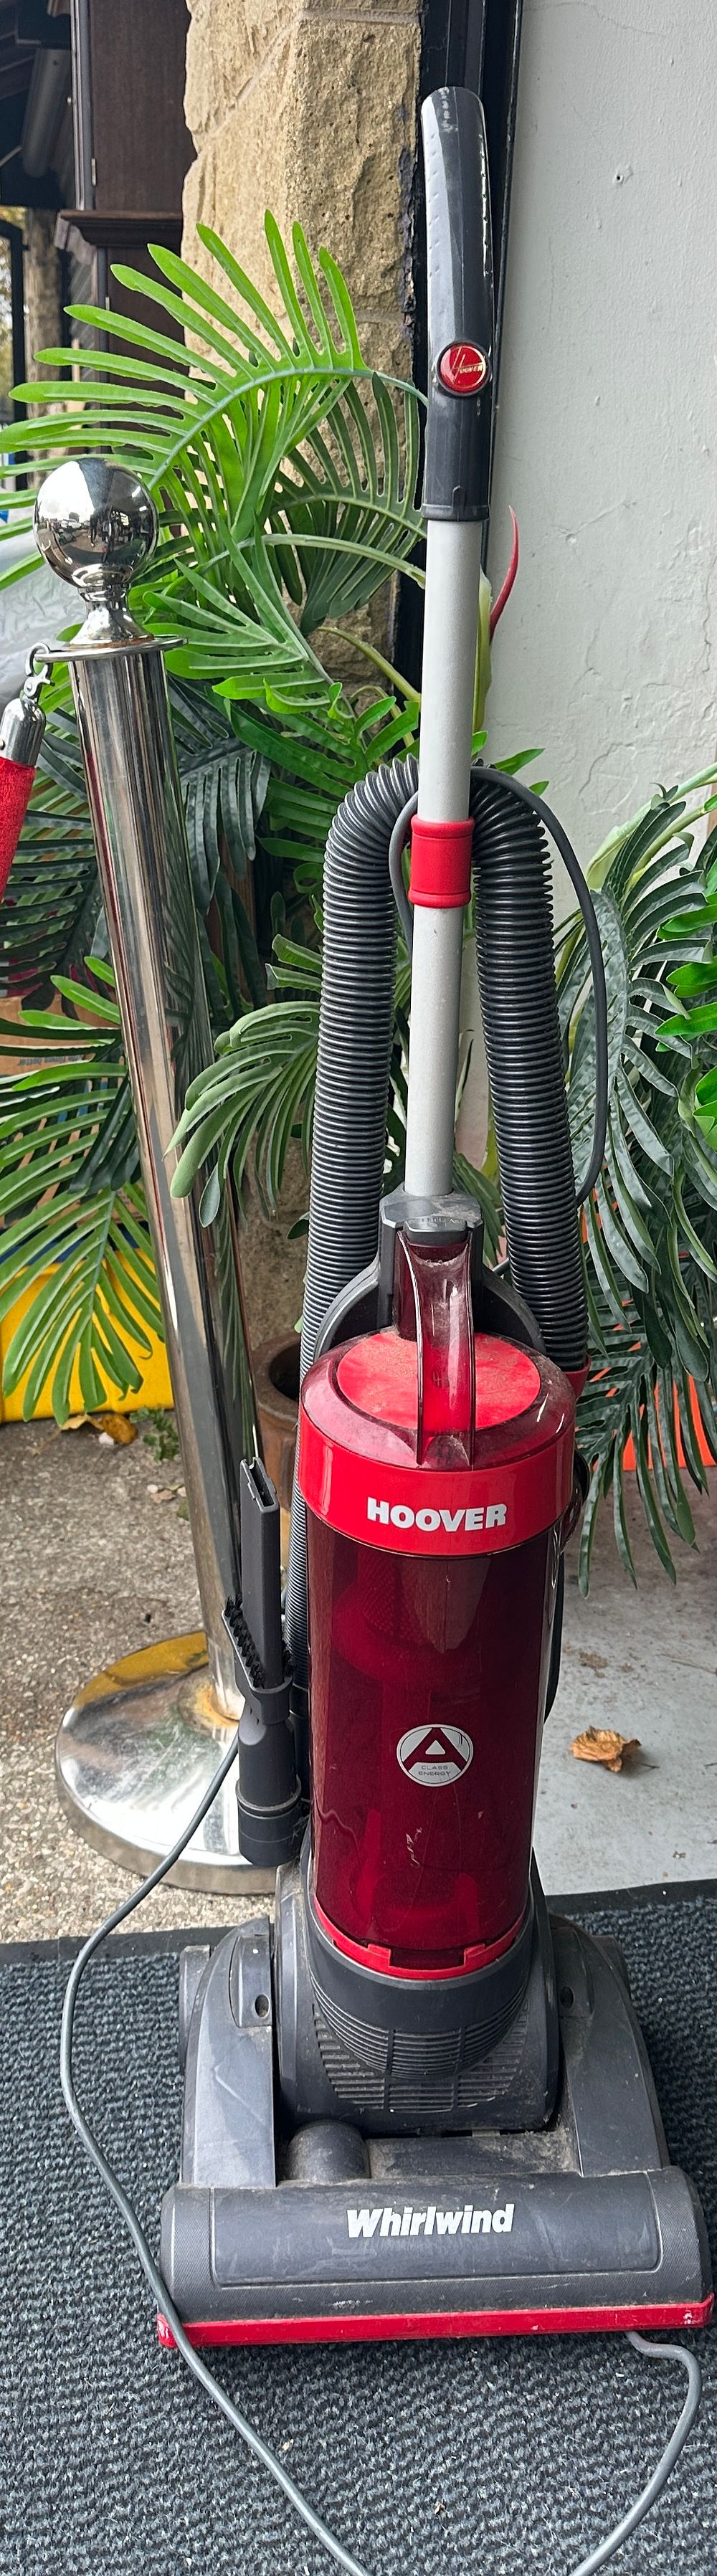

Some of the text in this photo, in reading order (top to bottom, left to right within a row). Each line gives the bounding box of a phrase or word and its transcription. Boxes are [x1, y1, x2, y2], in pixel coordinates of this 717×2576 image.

[367, 1496, 508, 1532] HOOVER
[402, 1726, 469, 1772] A
[346, 2203, 515, 2238] Whirlwind
